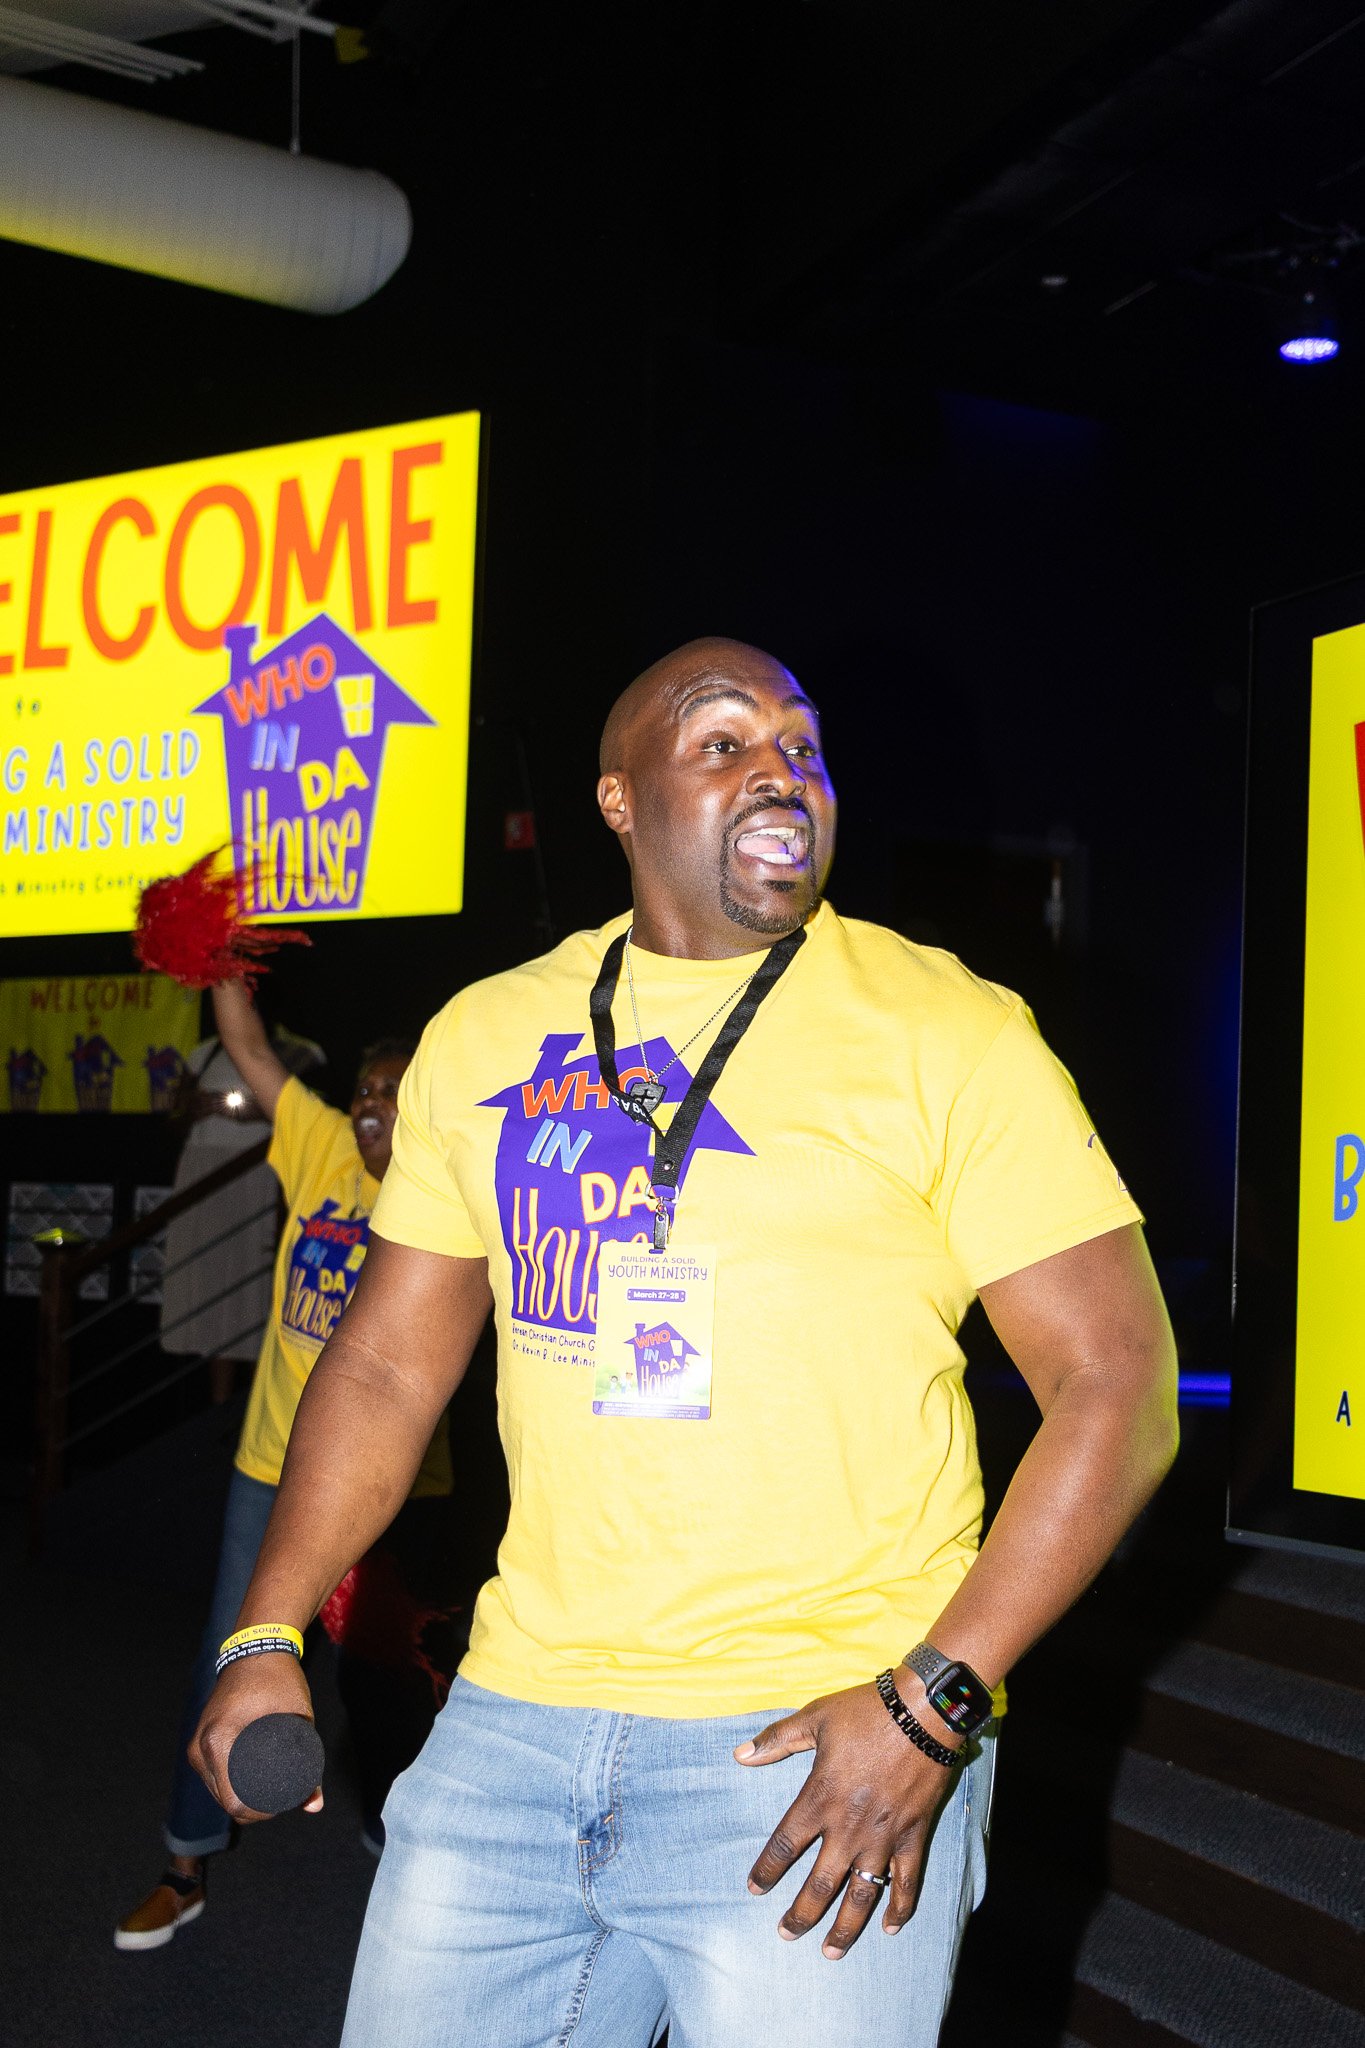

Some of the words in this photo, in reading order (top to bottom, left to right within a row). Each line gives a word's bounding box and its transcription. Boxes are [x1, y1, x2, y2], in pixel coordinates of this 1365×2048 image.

[224, 643, 336, 727] WHO
[250, 719, 300, 773] IN
[45, 741, 65, 789] A
[84, 729, 200, 786] SOLID
[297, 746, 371, 814] DA
[4, 797, 185, 855] MINISTRY
[526, 1118, 593, 1174] IN
[580, 1166, 657, 1224] DA
[304, 1218, 362, 1247] WHO
[620, 1255, 660, 1264] BUILDING
[662, 1256, 669, 1264] A
[671, 1257, 696, 1265] SOLID
[318, 1267, 347, 1294] DA
[608, 1264, 647, 1279] YOUTH
[650, 1266, 708, 1281] MINISTRY
[633, 1290, 658, 1299] March
[528, 1328, 558, 1344] Christian
[559, 1335, 586, 1349] Church
[634, 1329, 671, 1349] WHO
[522, 1343, 541, 1358] Kevin
[553, 1351, 568, 1363] Lee
[643, 1348, 660, 1363] IN
[658, 1357, 682, 1374] DA
[253, 1627, 282, 1635] Whos
